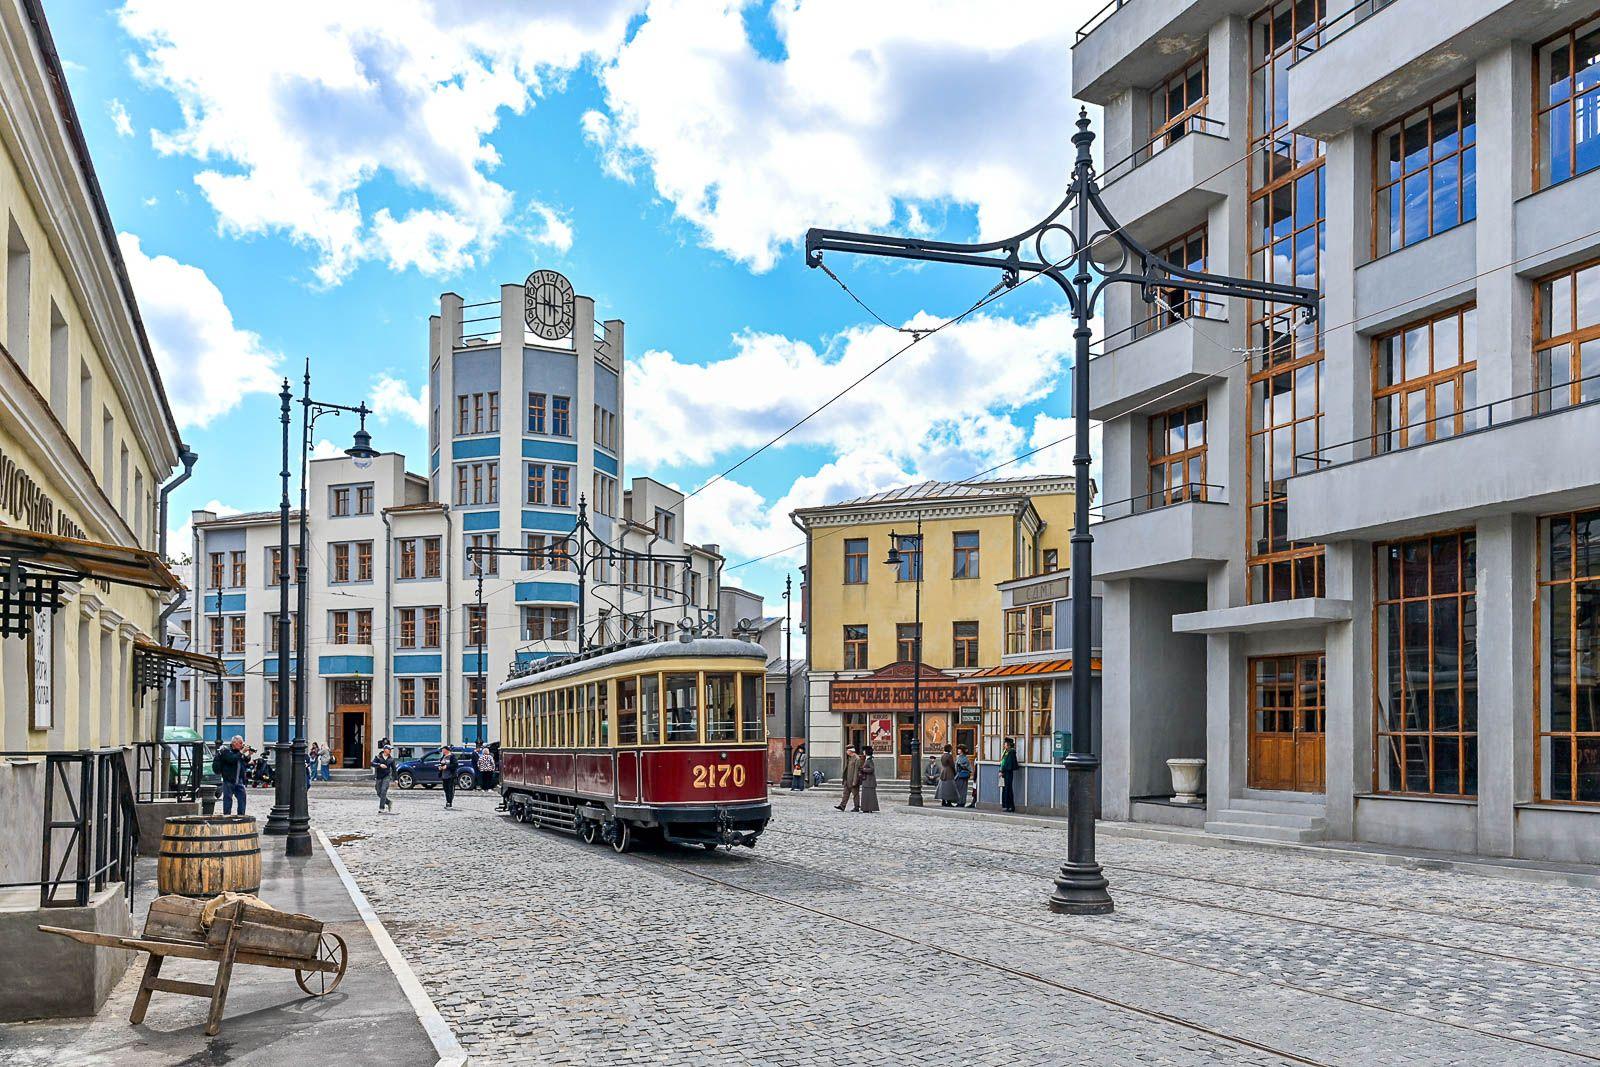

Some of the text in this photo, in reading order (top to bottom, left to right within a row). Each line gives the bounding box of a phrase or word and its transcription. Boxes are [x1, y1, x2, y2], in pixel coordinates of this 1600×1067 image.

[532, 274, 540, 284] 11
[546, 273, 555, 282] 12
[560, 280, 564, 288] 1
[526, 286, 535, 295] 10
[566, 293, 570, 301] 2
[527, 299, 533, 307] 9
[566, 305, 571, 313] 3
[566, 317, 570, 326] 4
[534, 322, 540, 330] 7
[559, 326, 564, 334] 5
[692, 764, 746, 789] 2170
